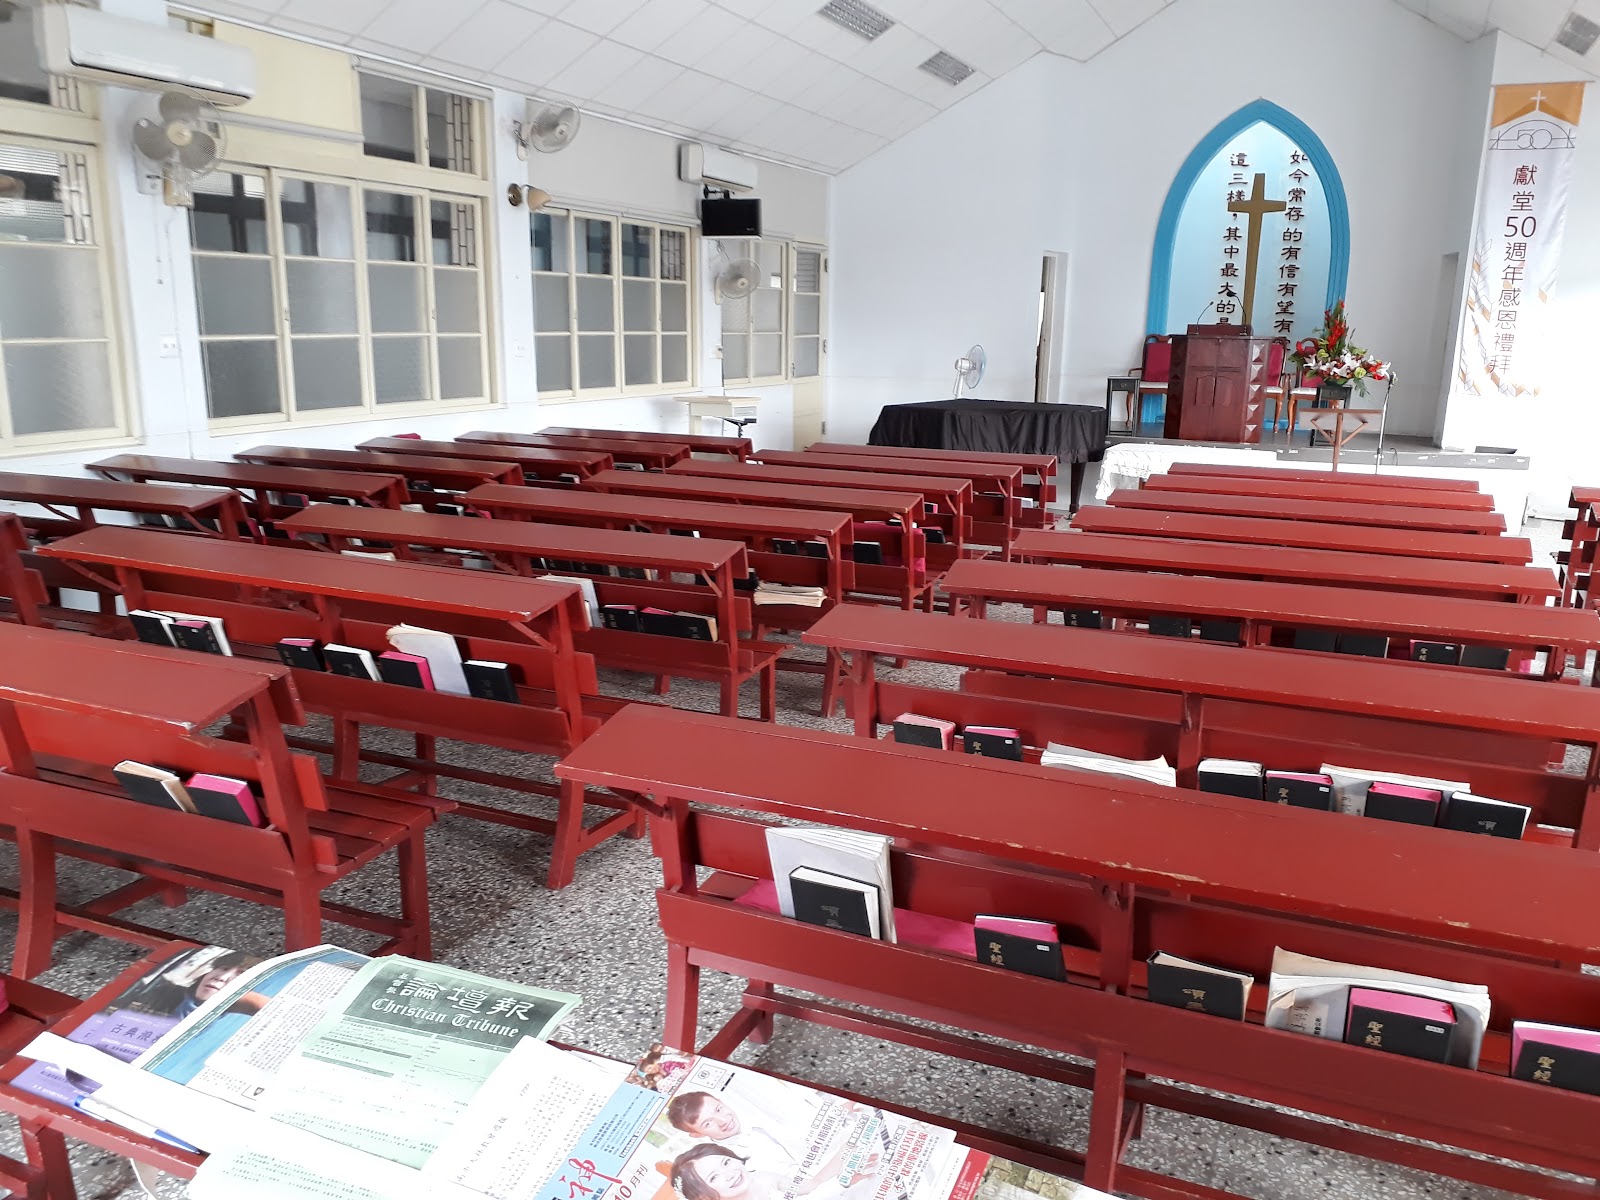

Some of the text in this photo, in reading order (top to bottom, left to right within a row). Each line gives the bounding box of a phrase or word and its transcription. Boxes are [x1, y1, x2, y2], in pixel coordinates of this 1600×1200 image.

[1273, 150, 1309, 347] 如今常存的有信有望有
[371, 998, 520, 1038] Christian Tribune
